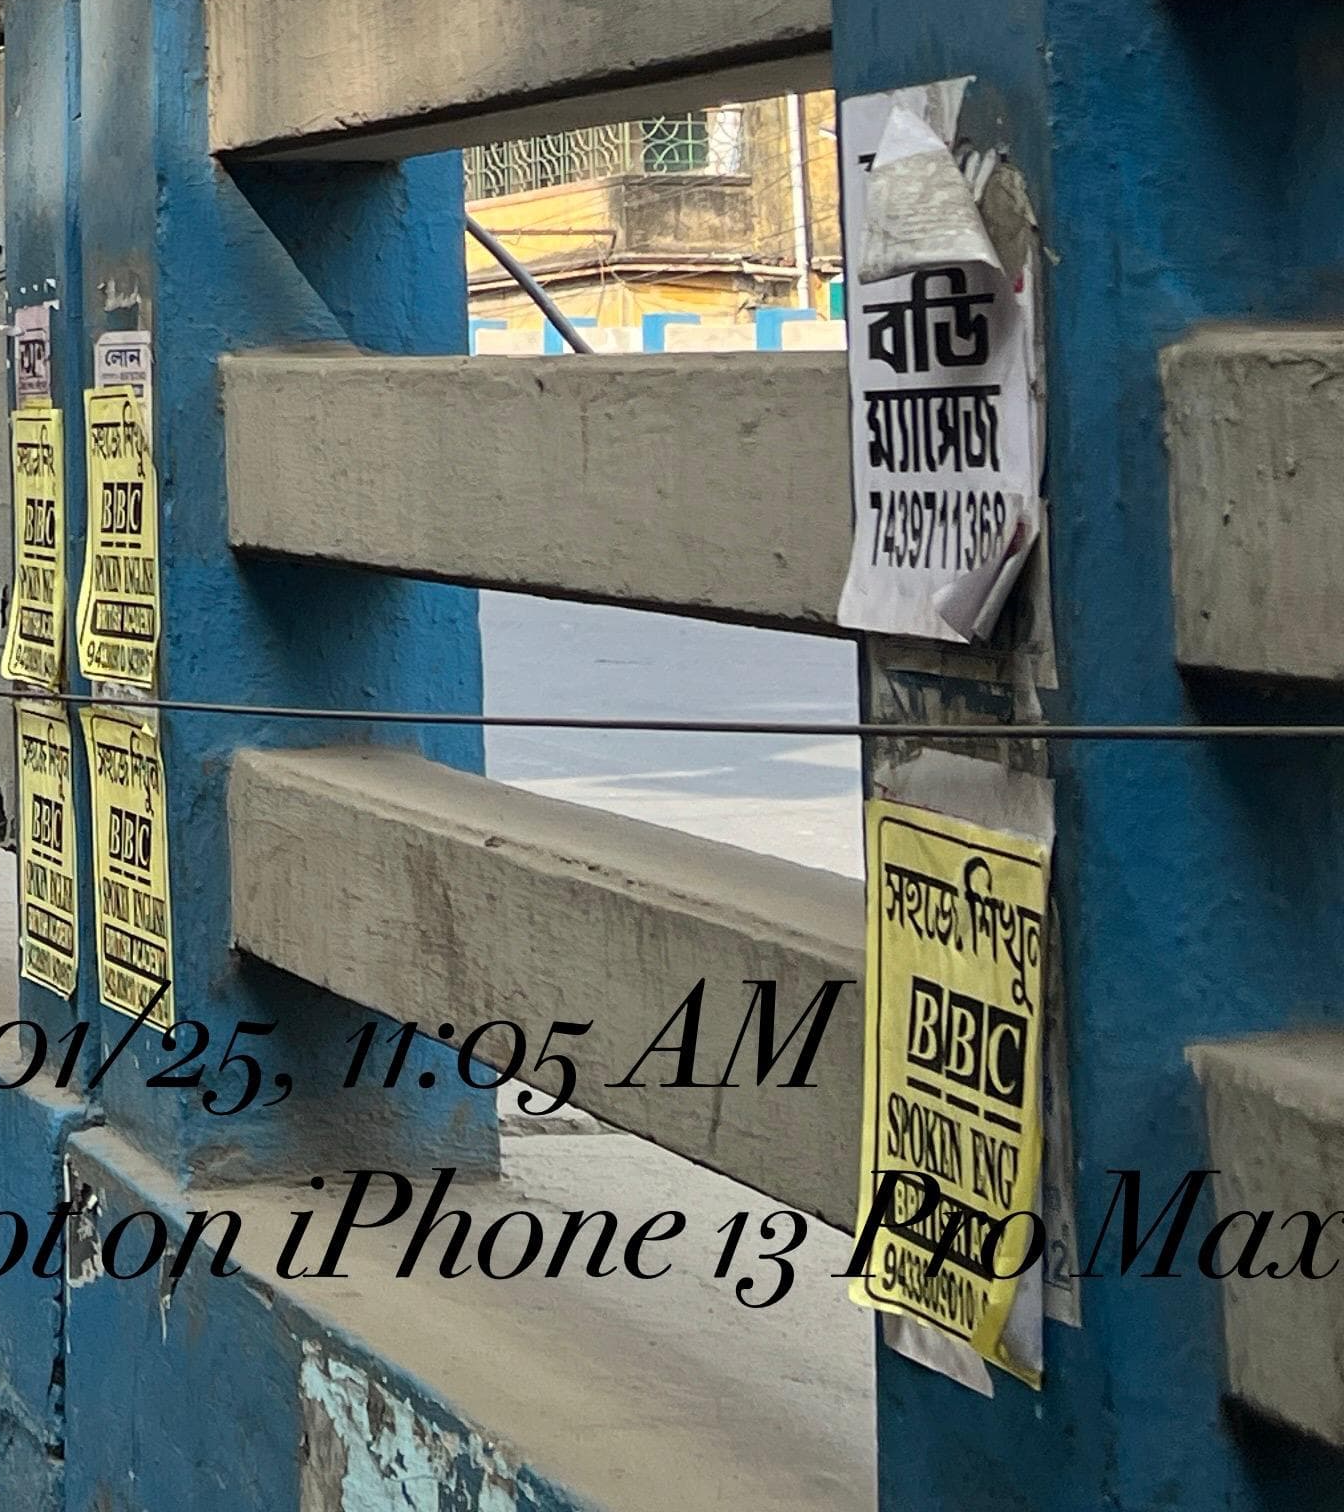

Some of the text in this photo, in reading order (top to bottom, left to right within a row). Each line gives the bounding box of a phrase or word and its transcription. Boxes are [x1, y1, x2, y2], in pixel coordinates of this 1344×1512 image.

[105, 348, 141, 368] লোন
[863, 268, 994, 374] বডি
[864, 385, 1002, 473] ম্যাসেজ
[25, 498, 56, 548] BBC
[101, 482, 144, 534] BBC
[32, 793, 64, 853] BBC
[109, 805, 152, 872] BBC
[885, 862, 963, 953] সহজে
[907, 975, 1030, 1108] BBC
[887, 1092, 962, 1188] SPOKEN
